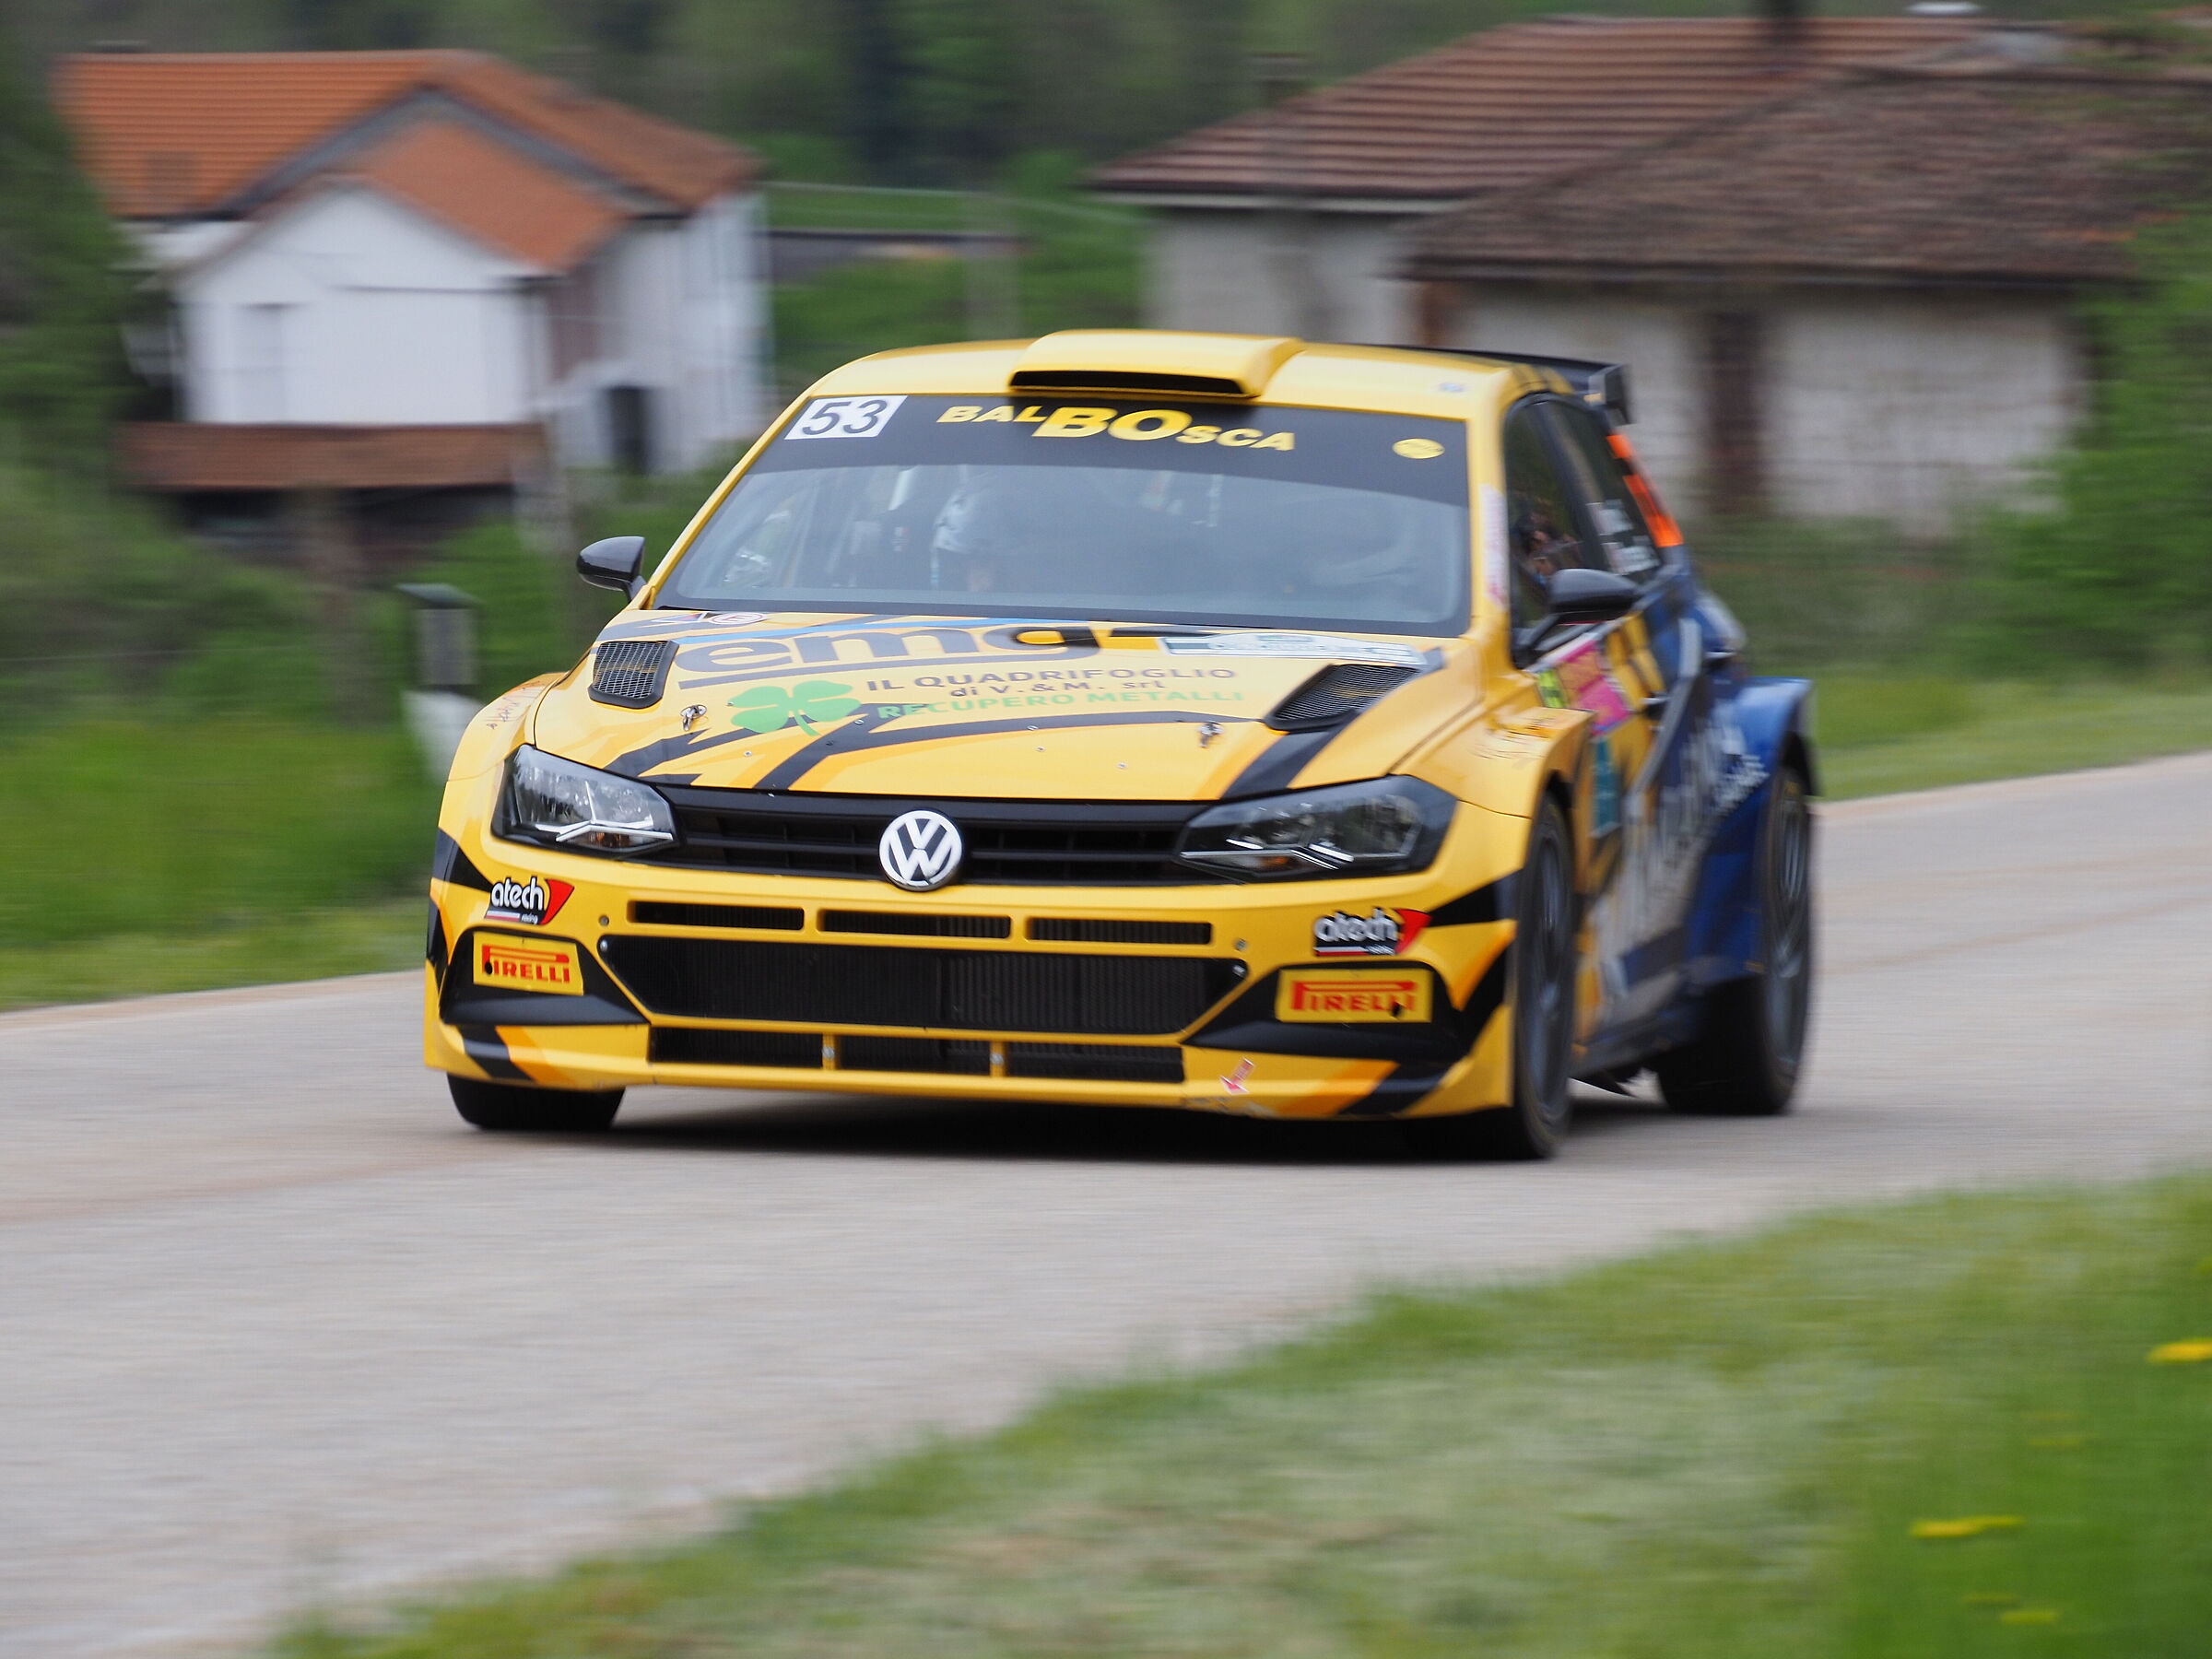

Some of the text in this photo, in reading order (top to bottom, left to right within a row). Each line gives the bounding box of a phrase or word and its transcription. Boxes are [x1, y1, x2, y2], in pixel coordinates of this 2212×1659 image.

[801, 399, 889, 436] 53
[935, 406, 1295, 452] BALBOSCA
[867, 669, 1235, 691] IL QUADRIFOGLIO
[950, 687, 979, 697] di
[877, 691, 1243, 719] RECUPERO METALLI
[491, 877, 544, 911] atech
[483, 946, 570, 983] PIRELLI
[1291, 982, 1418, 1012] PIRELLI
